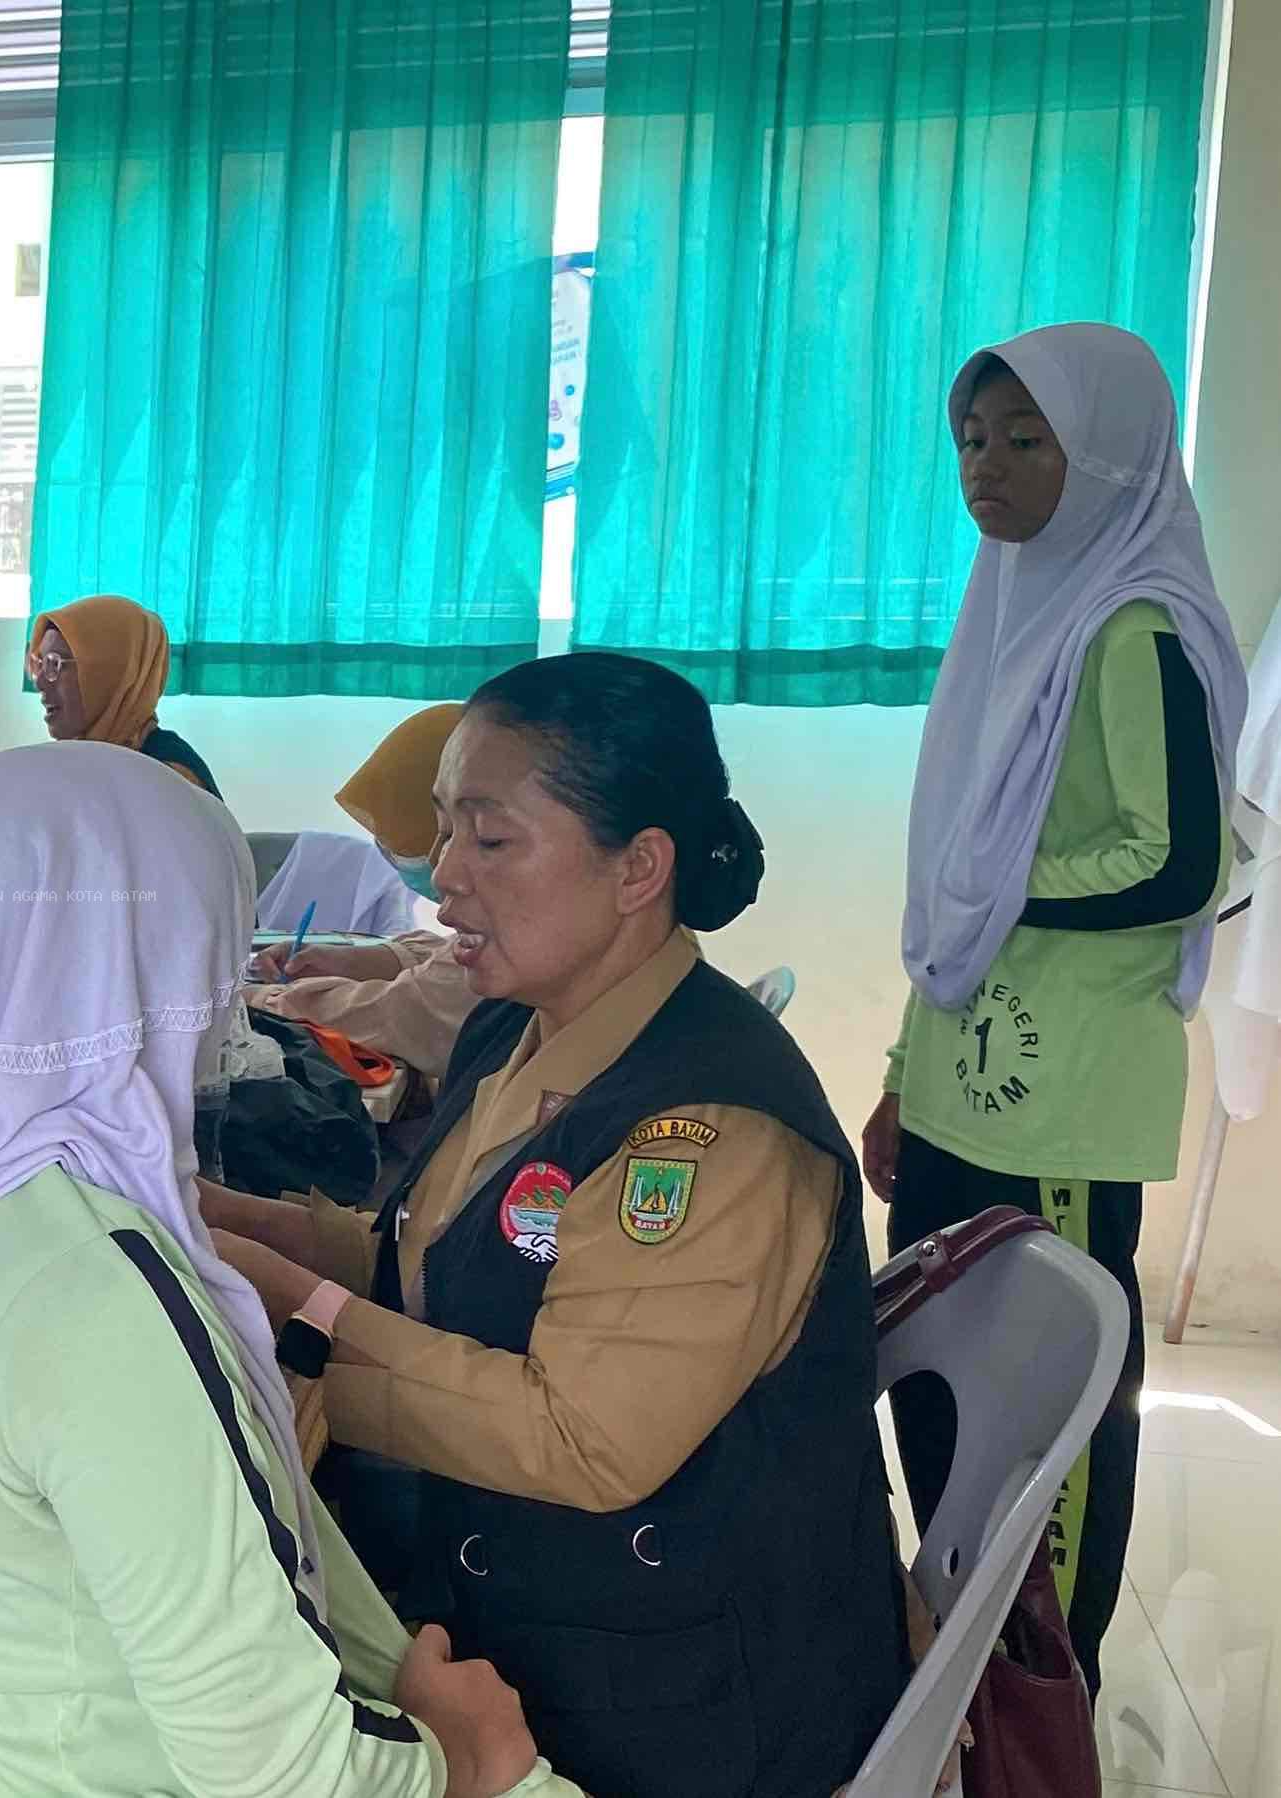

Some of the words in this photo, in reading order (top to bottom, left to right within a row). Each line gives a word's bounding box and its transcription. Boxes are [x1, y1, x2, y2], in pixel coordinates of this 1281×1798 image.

[974, 1017, 993, 1075] 1
[629, 1121, 665, 1145] KOTA
[670, 1120, 714, 1145] BATAM
